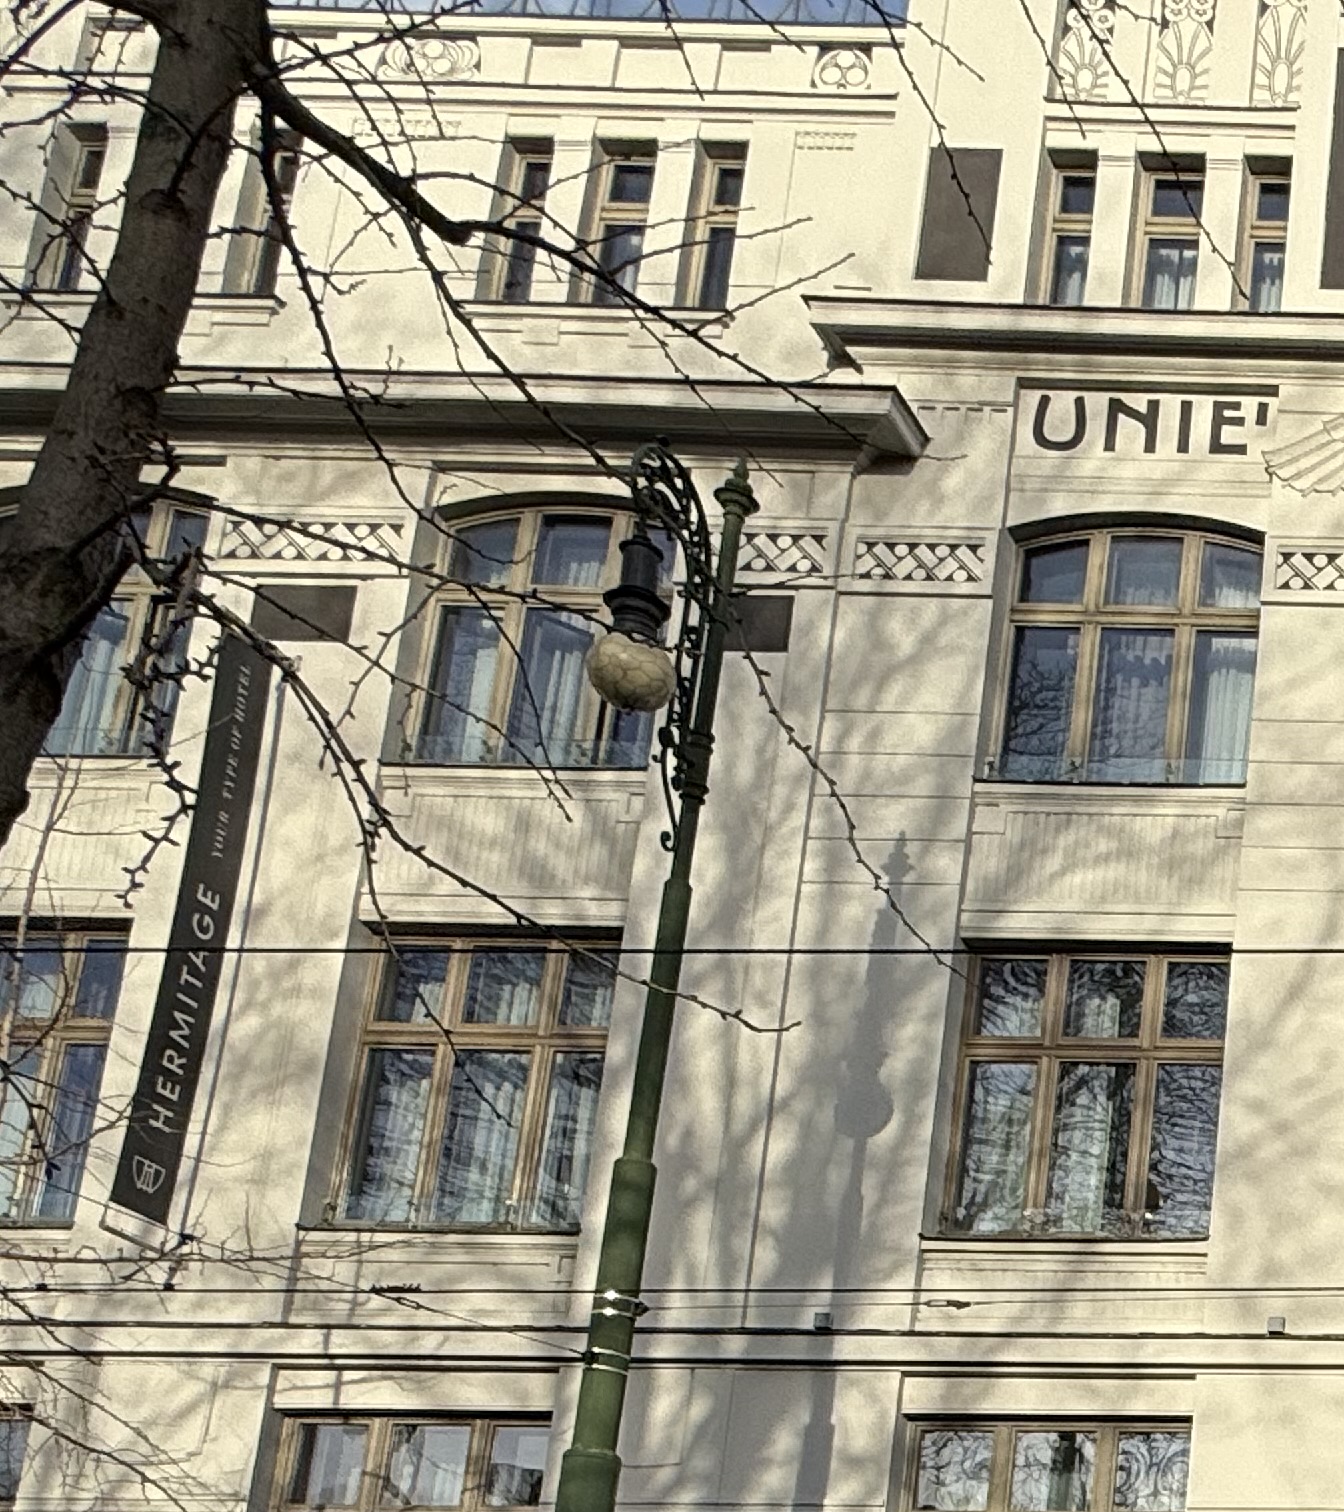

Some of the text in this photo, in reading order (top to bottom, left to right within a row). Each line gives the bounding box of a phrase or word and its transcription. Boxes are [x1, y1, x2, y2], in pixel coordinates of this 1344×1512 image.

[235, 663, 252, 723] HOTEL
[232, 725, 244, 749] OF
[222, 753, 240, 800] TYPE
[148, 882, 222, 1135] HERMITAGE
